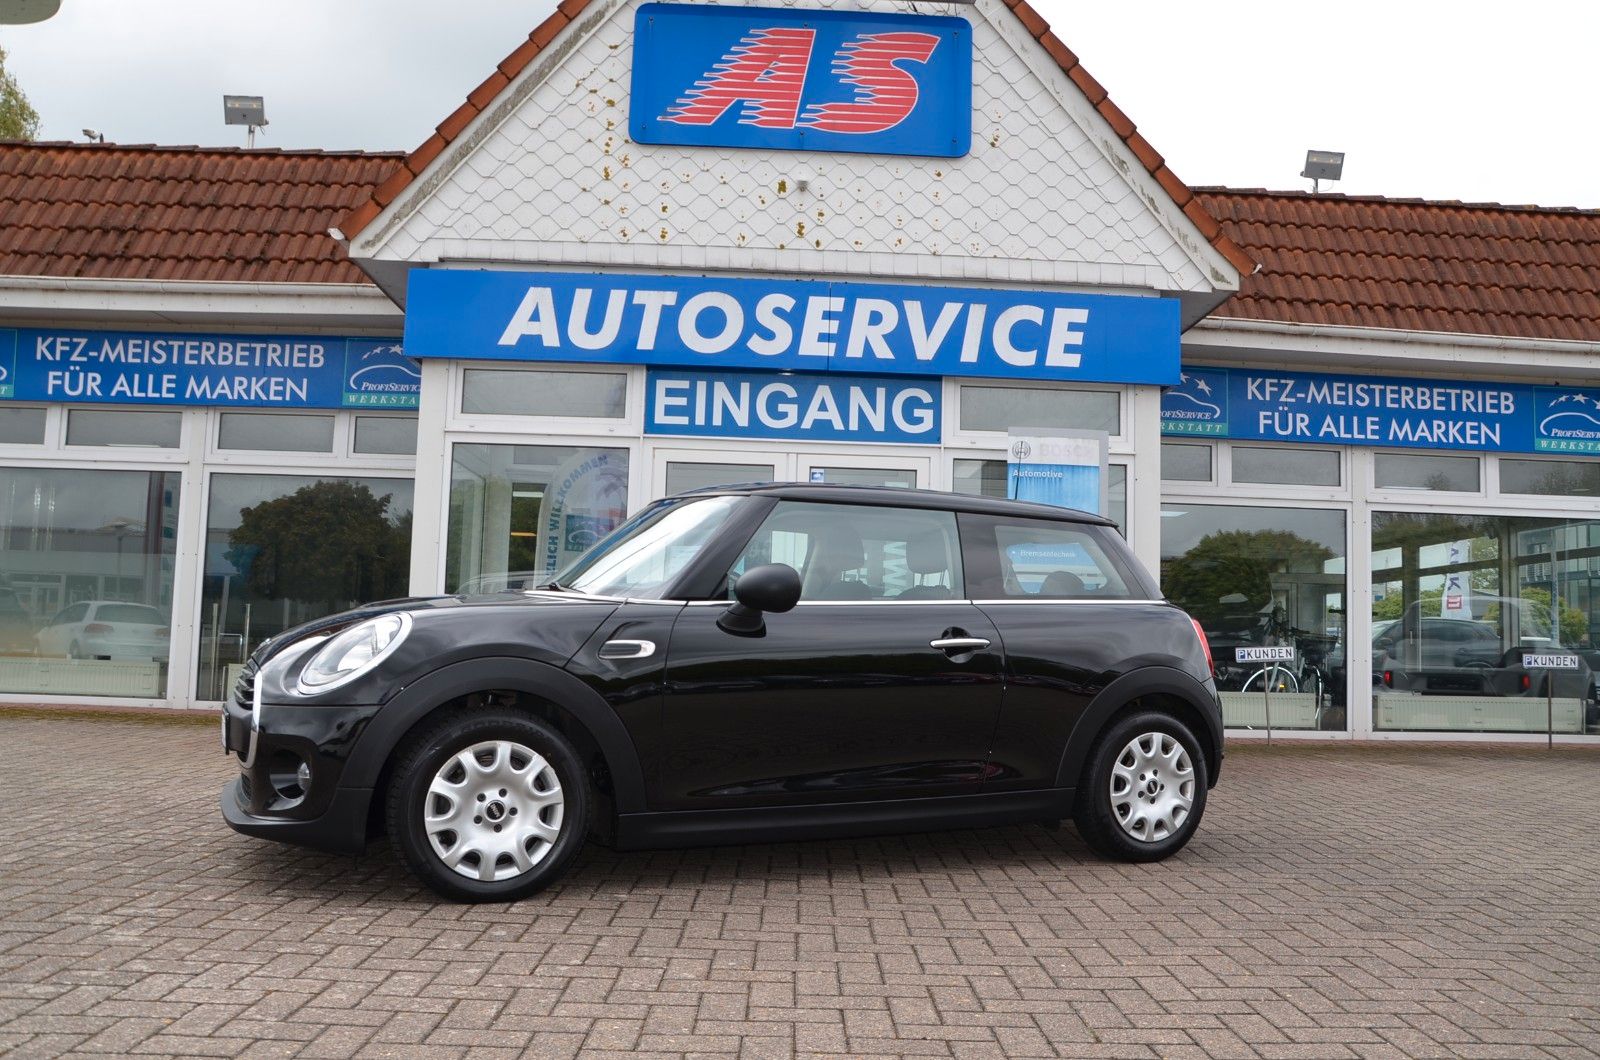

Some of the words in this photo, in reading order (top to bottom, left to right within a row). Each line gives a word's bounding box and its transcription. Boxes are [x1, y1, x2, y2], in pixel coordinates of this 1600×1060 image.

[656, 27, 941, 135] AS
[497, 286, 1090, 369] AUTOSERVICE
[36, 336, 325, 368] KFZ-MEISTERBETRIEB
[47, 366, 103, 397] FÜR
[110, 372, 177, 399] ALLE
[185, 375, 308, 402] MARKEN
[361, 381, 421, 392] PROFISERVIC
[348, 394, 416, 405] WERKSTA
[653, 378, 935, 435] EINGANG
[1246, 377, 1515, 415] KFZ-MEISTERBETRIEB
[1160, 422, 1222, 433] RKSTATT
[1258, 405, 1311, 437] FÜR
[1319, 415, 1379, 440] ALLE
[1388, 418, 1500, 446] MARKEN
[1541, 440, 1600, 450] WERKSTA
[1012, 469, 1063, 479] Automotive
[1247, 648, 1292, 659] KUNDEN
[1534, 656, 1576, 666] KUNDEN
